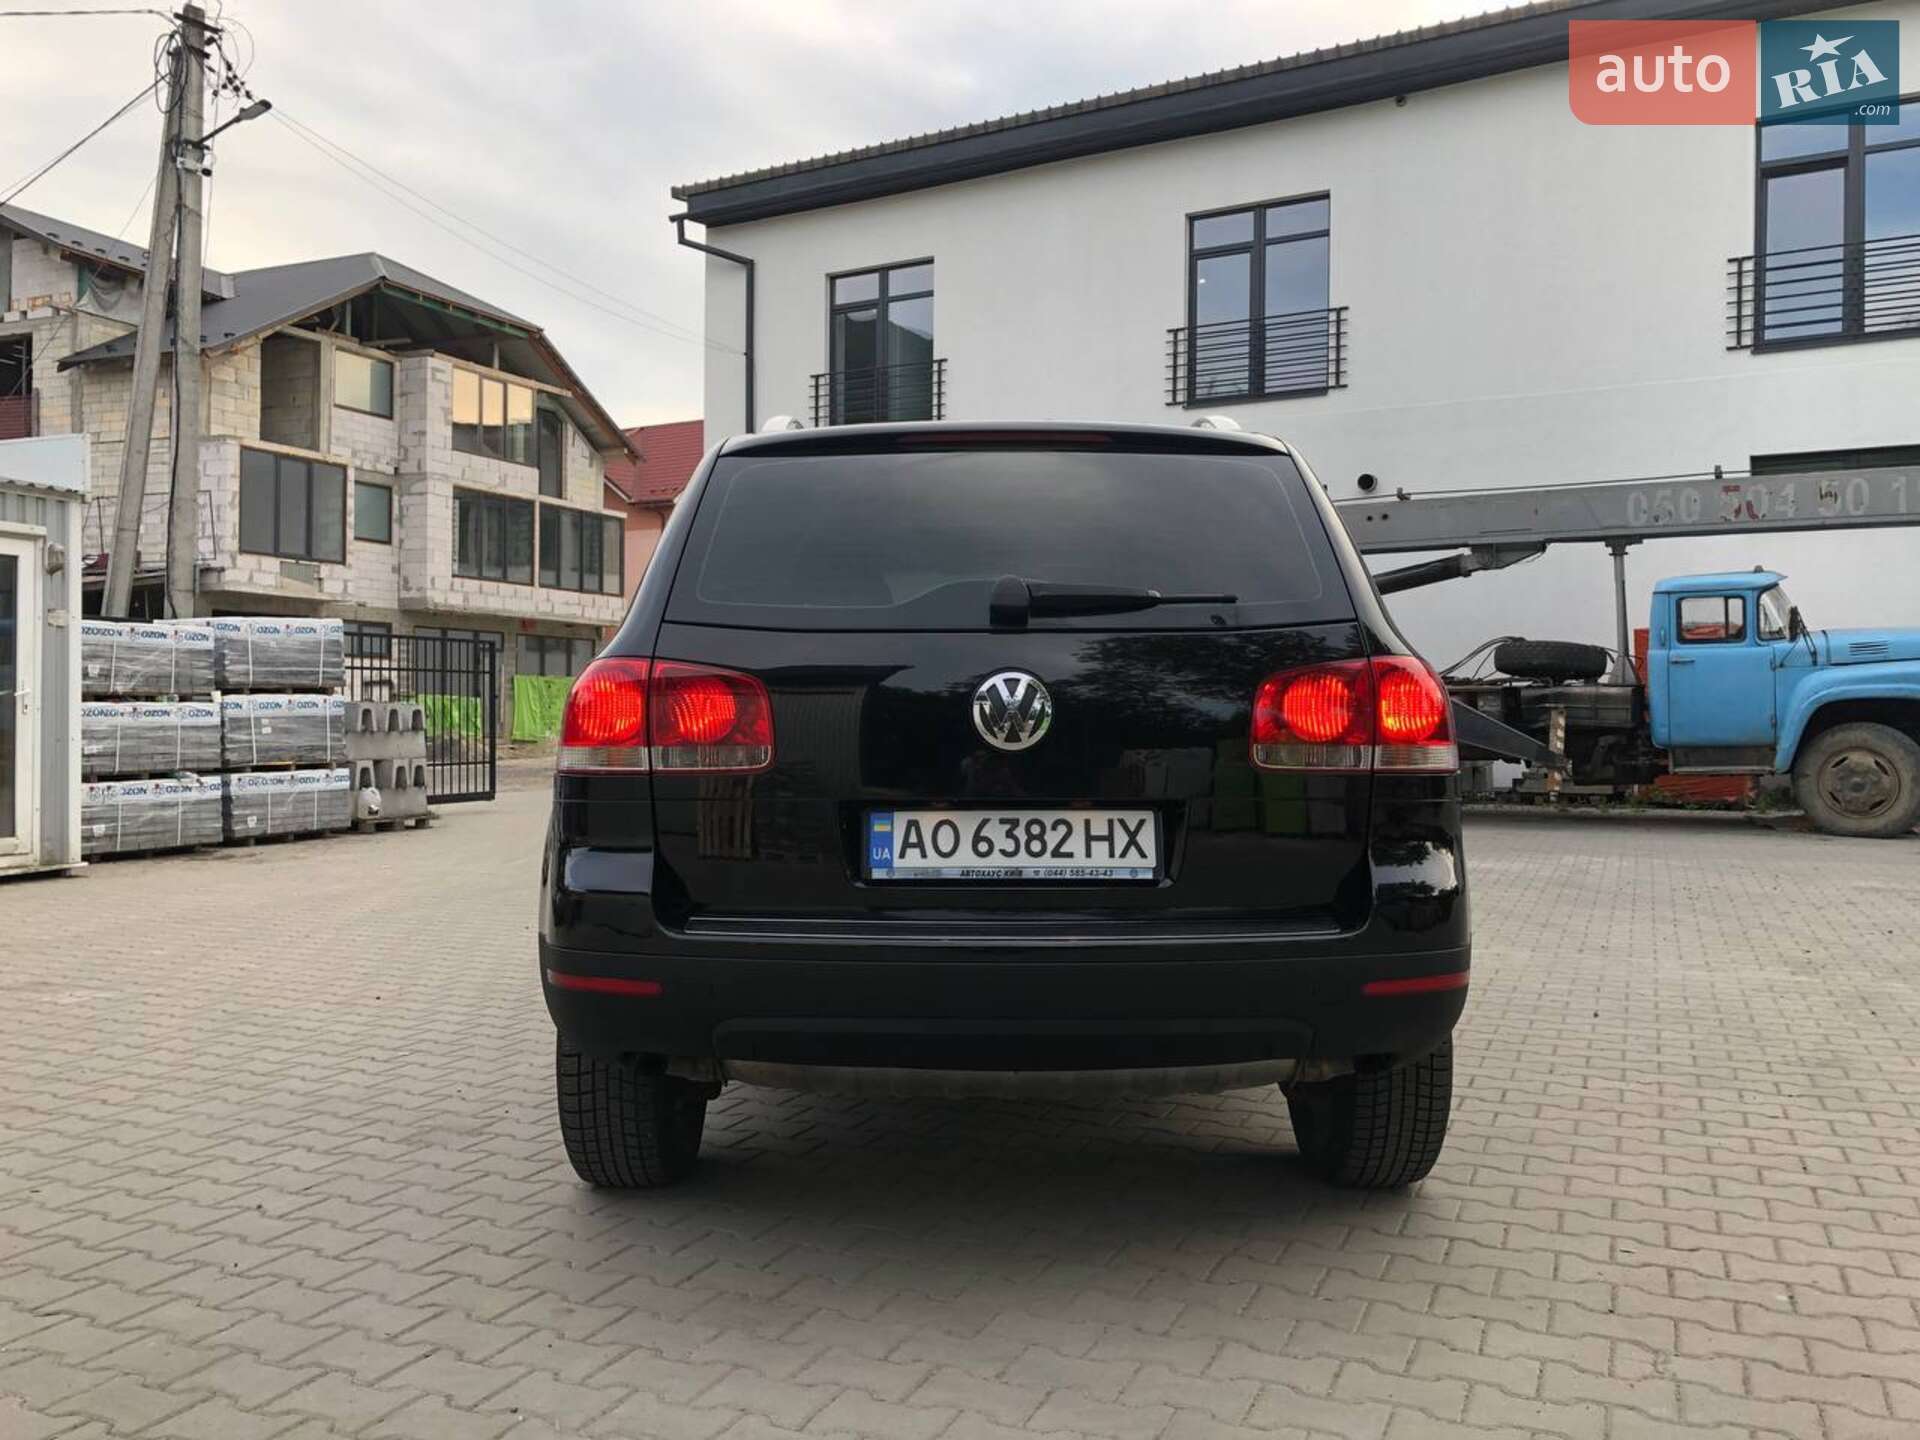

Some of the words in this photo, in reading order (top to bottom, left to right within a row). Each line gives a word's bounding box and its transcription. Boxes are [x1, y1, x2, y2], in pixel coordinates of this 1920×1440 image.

[1626, 487, 1701, 526] 050
[140, 630, 168, 640] OZON
[184, 632, 209, 642] OZON
[257, 626, 280, 634] OZON
[295, 626, 317, 634] OZON
[259, 701, 282, 710] OZON
[297, 701, 319, 709] OZON
[143, 709, 170, 718] OZON
[188, 709, 214, 718] OZON
[898, 818, 961, 859] AO
[971, 817, 1074, 859] 6382
[1084, 817, 1148, 859] HX
[873, 848, 891, 860] UA
